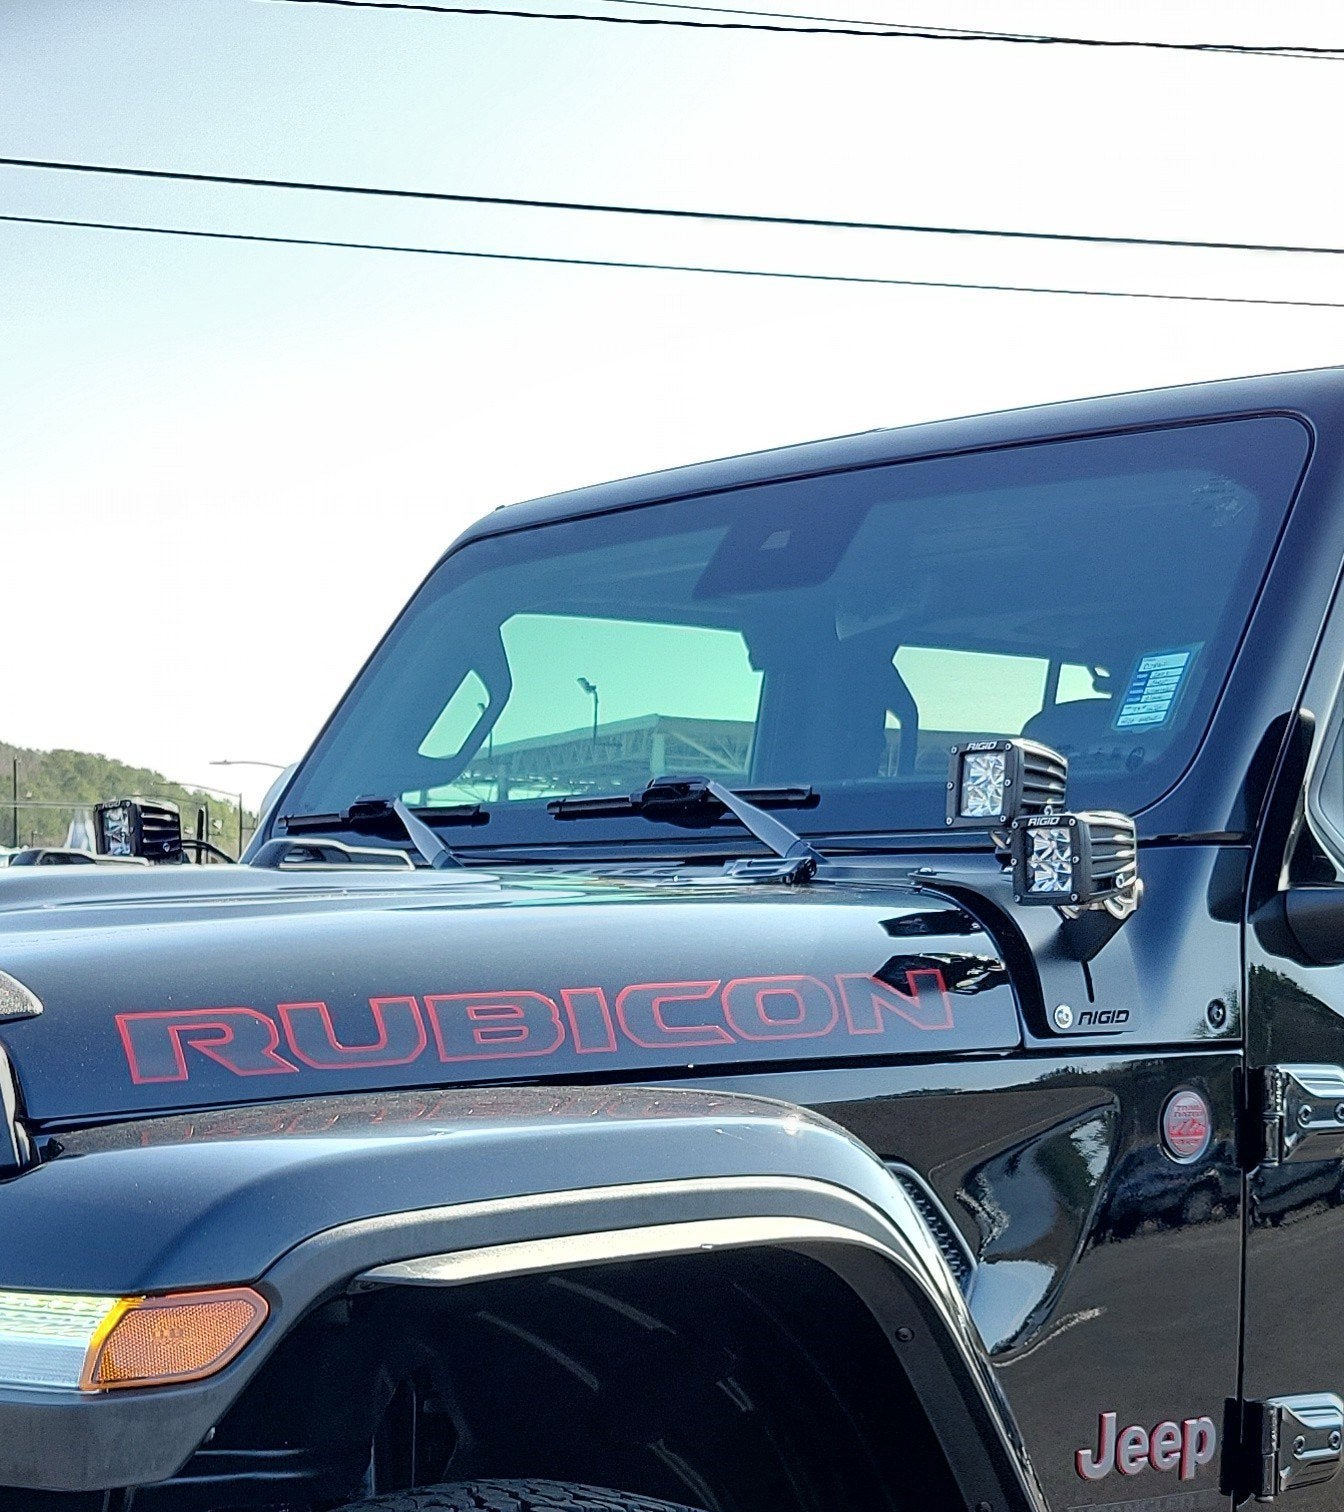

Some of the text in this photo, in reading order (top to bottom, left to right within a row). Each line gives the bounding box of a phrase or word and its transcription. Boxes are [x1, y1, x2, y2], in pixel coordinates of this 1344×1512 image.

[966, 741, 997, 751] RIGID
[1027, 816, 1060, 827] RIGID
[1077, 1009, 1130, 1026] RIGID
[115, 968, 956, 1086] RUBICON
[1075, 1410, 1217, 1481] Jeep
